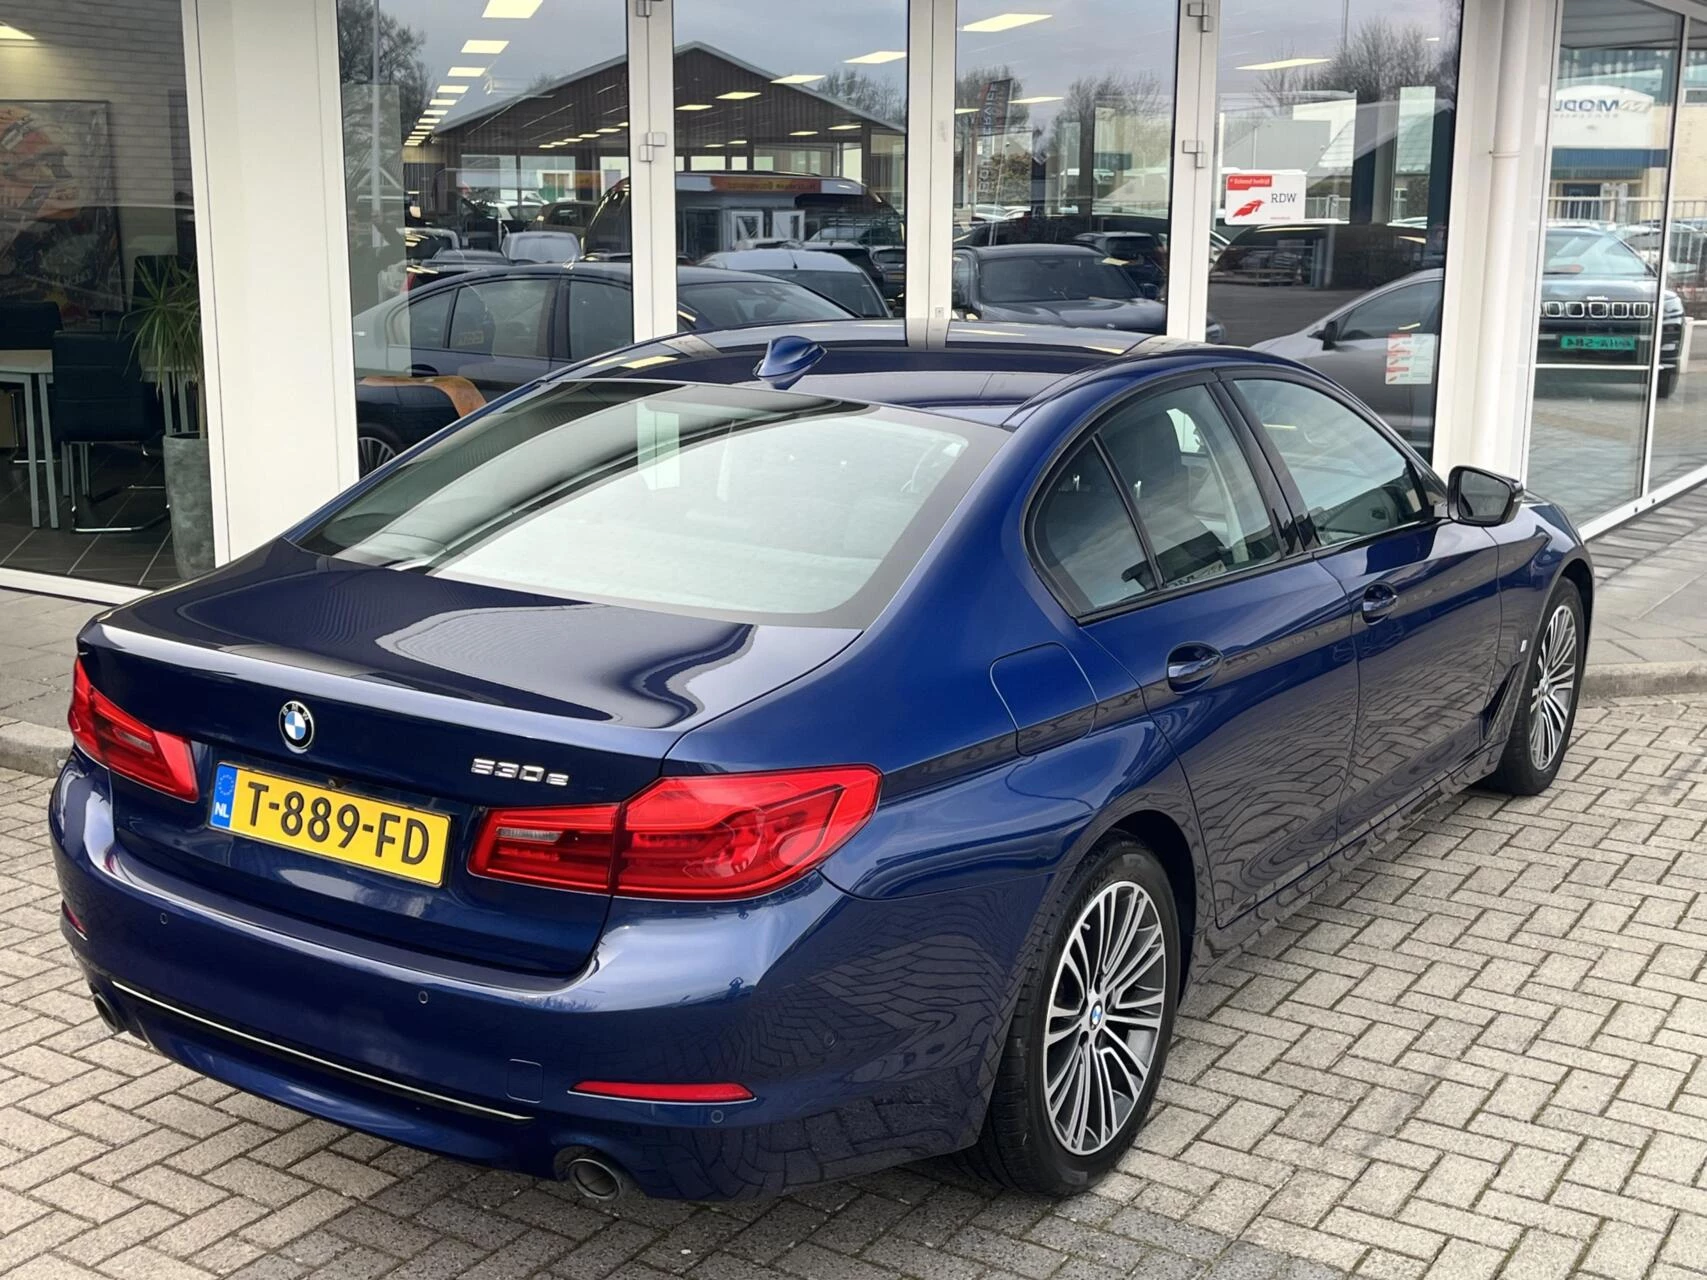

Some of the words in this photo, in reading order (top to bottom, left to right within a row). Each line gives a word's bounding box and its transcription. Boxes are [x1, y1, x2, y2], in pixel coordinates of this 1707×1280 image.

[1270, 193, 1296, 204] RDW
[282, 703, 309, 720] BMW
[214, 802, 229, 818] NL
[248, 781, 430, 865] T-889-FD
